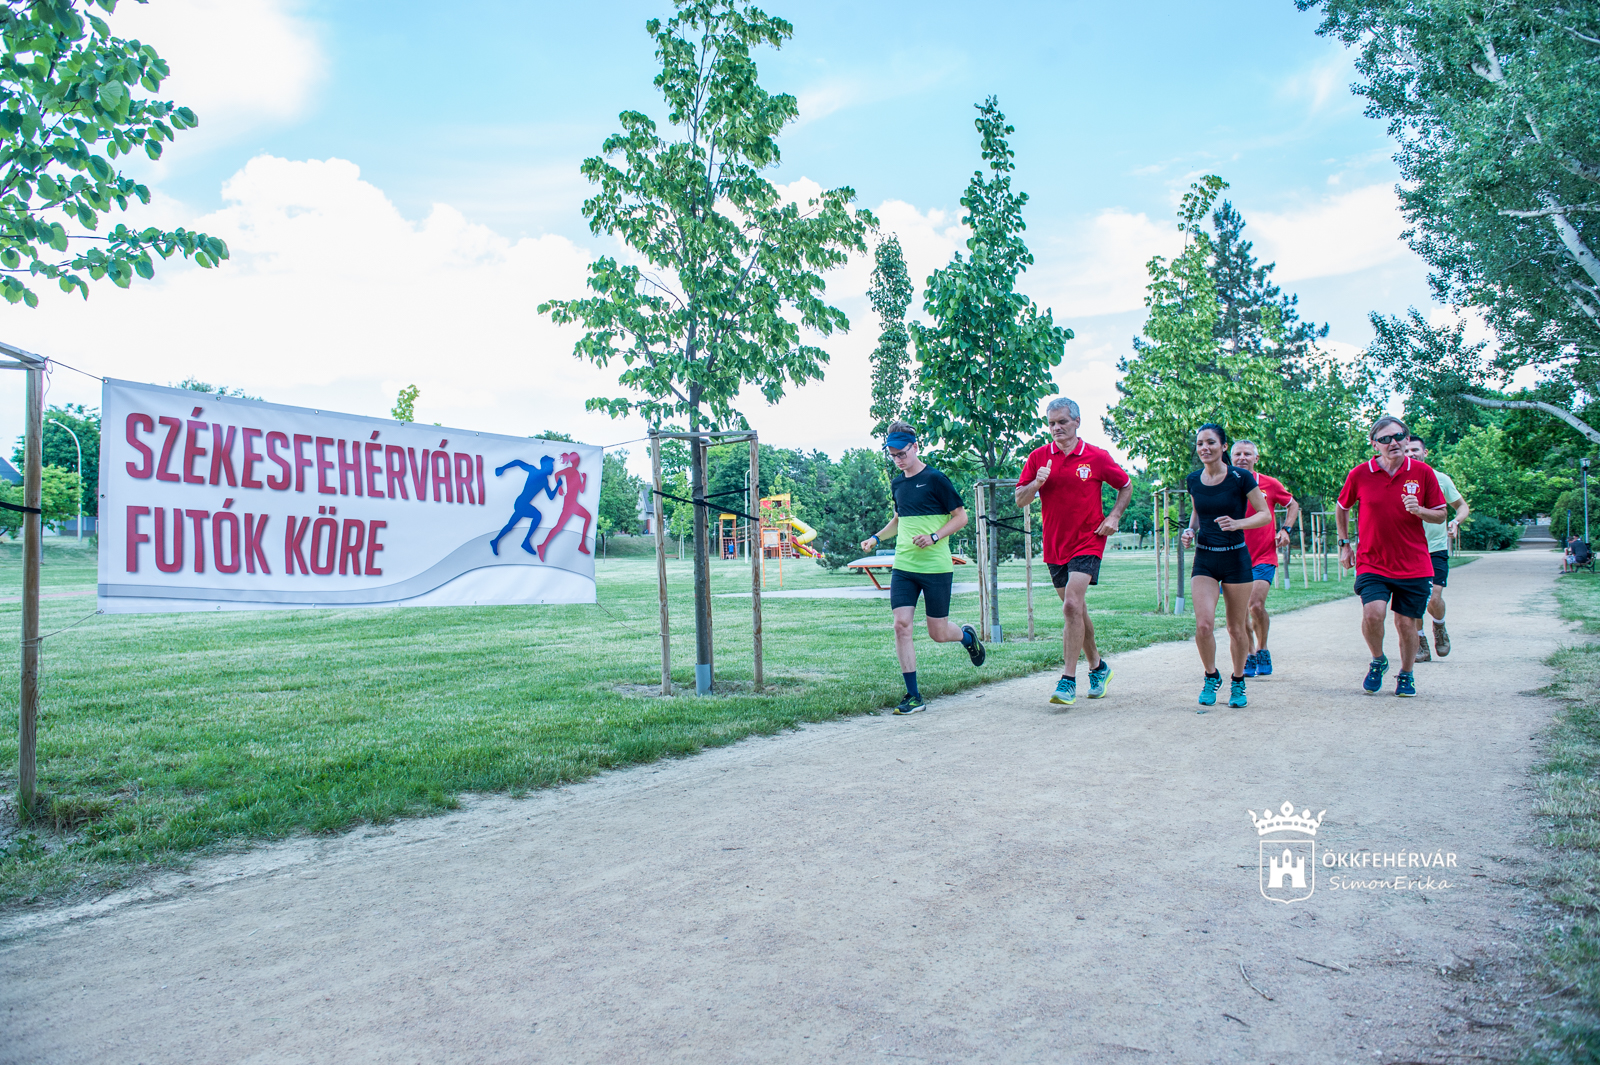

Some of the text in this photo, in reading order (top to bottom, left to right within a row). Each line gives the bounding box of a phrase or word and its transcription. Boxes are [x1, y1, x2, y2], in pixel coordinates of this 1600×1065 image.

[126, 406, 485, 505] SZÉKESFEHÉRVÁRI
[126, 498, 387, 575] FUTÓK KÖRE
